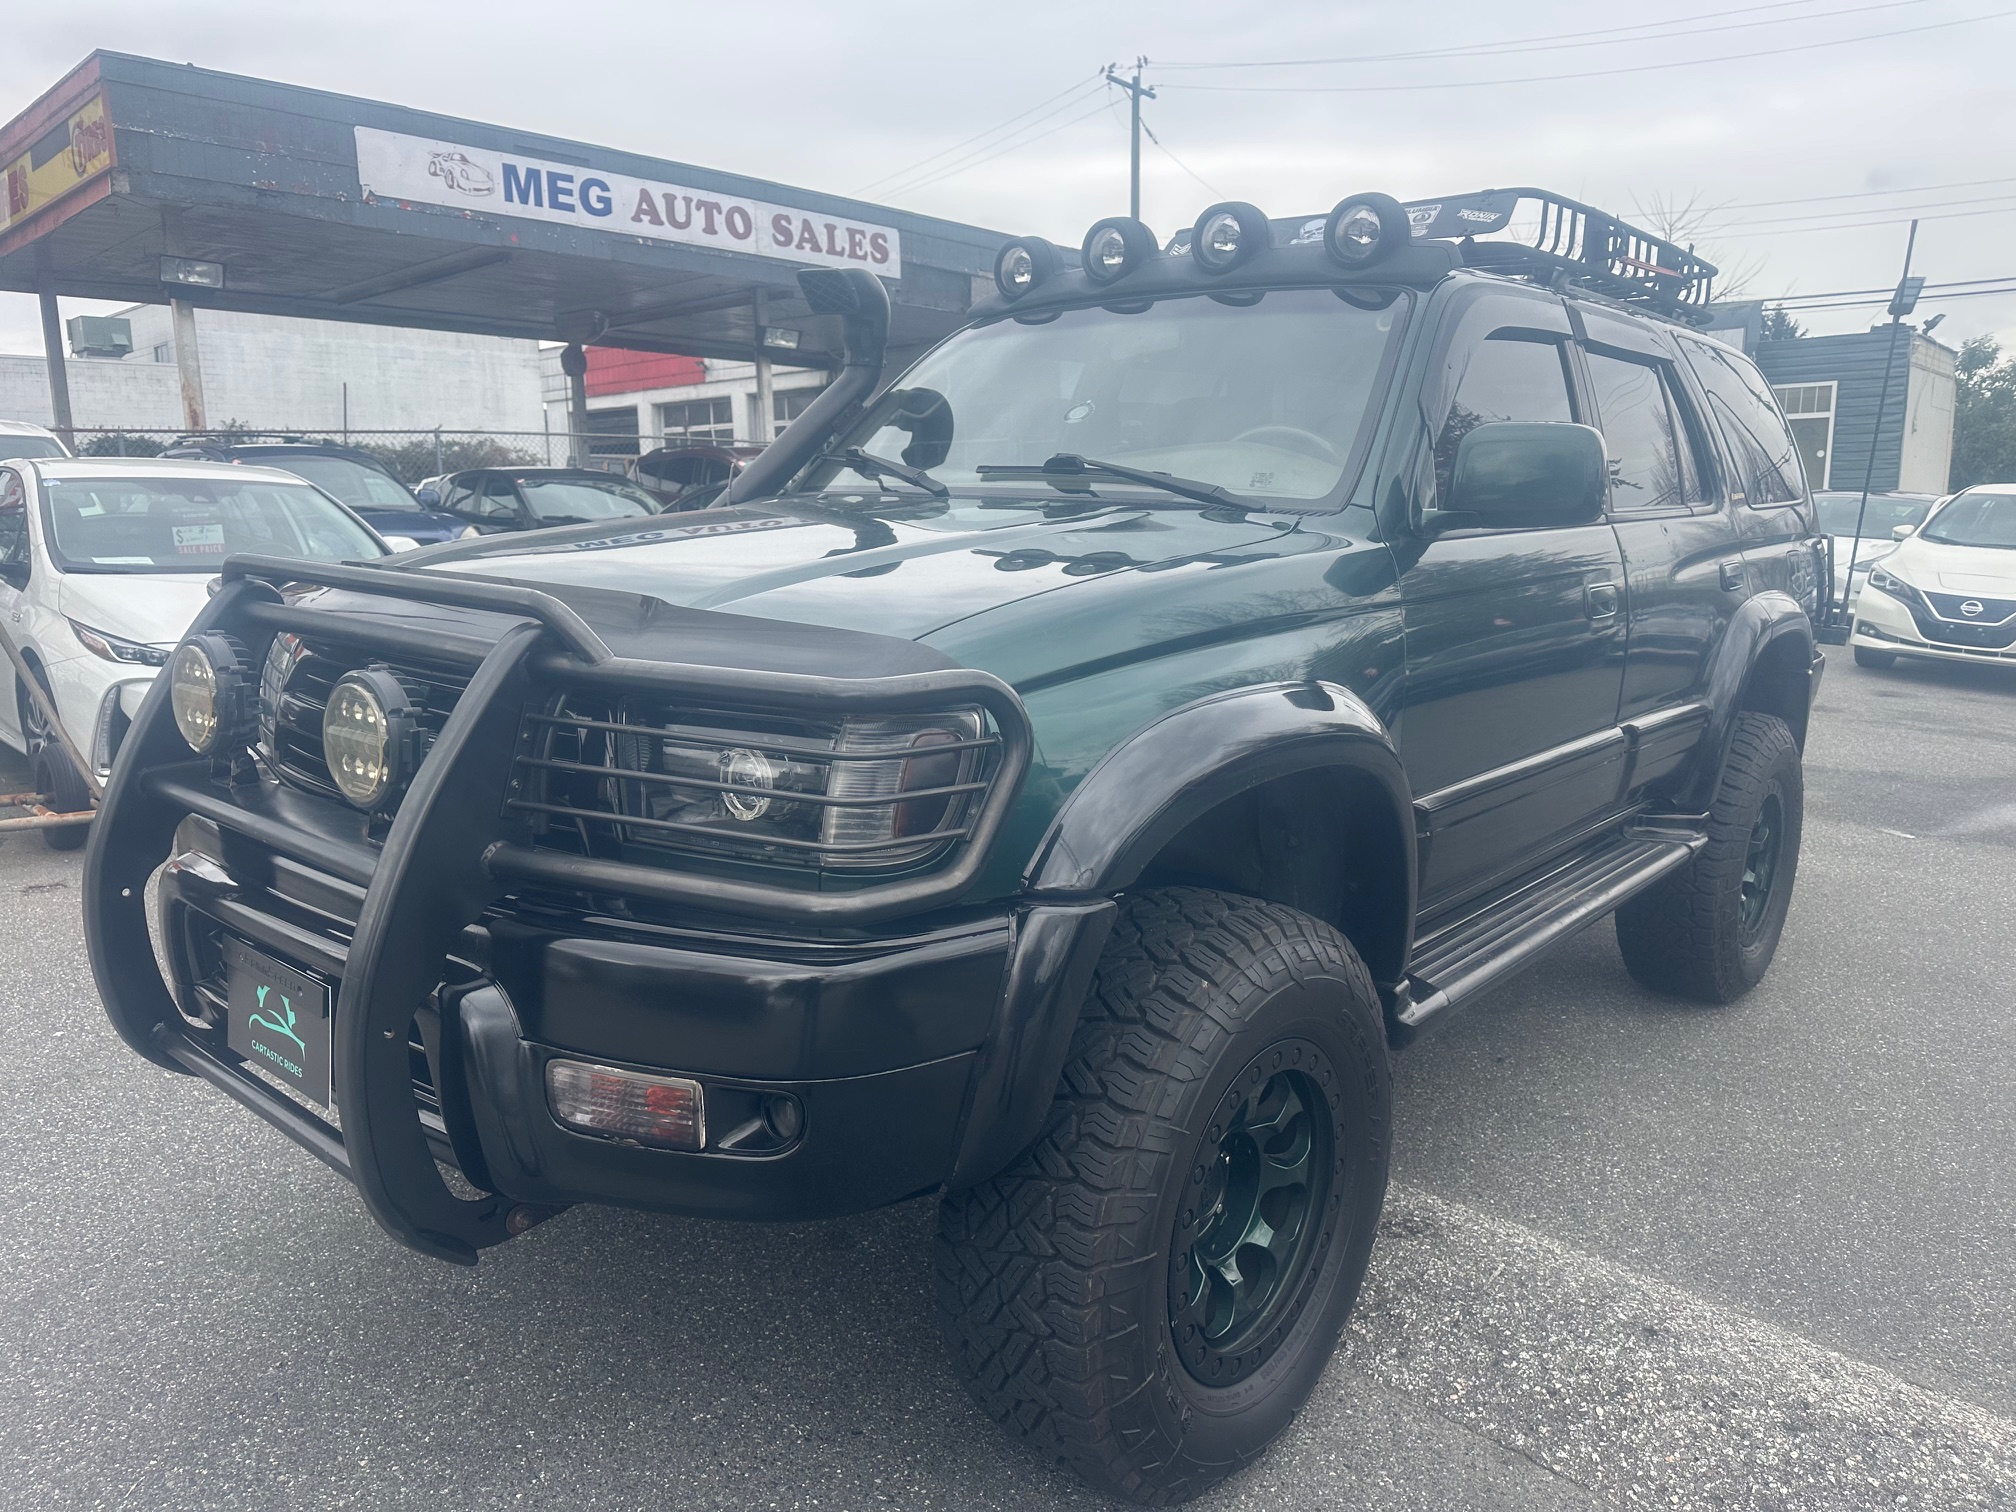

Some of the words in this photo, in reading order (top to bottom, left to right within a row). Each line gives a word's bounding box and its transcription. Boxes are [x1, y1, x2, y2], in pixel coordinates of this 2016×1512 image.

[502, 163, 612, 217] MEG
[631, 188, 753, 240] AUTO
[771, 214, 889, 264] SALES
[176, 529, 184, 545] $
[178, 545, 198, 554] SALE
[199, 544, 223, 554] PRICE
[251, 1039, 284, 1066] CARTASTIC
[284, 1058, 303, 1078] RIDES
